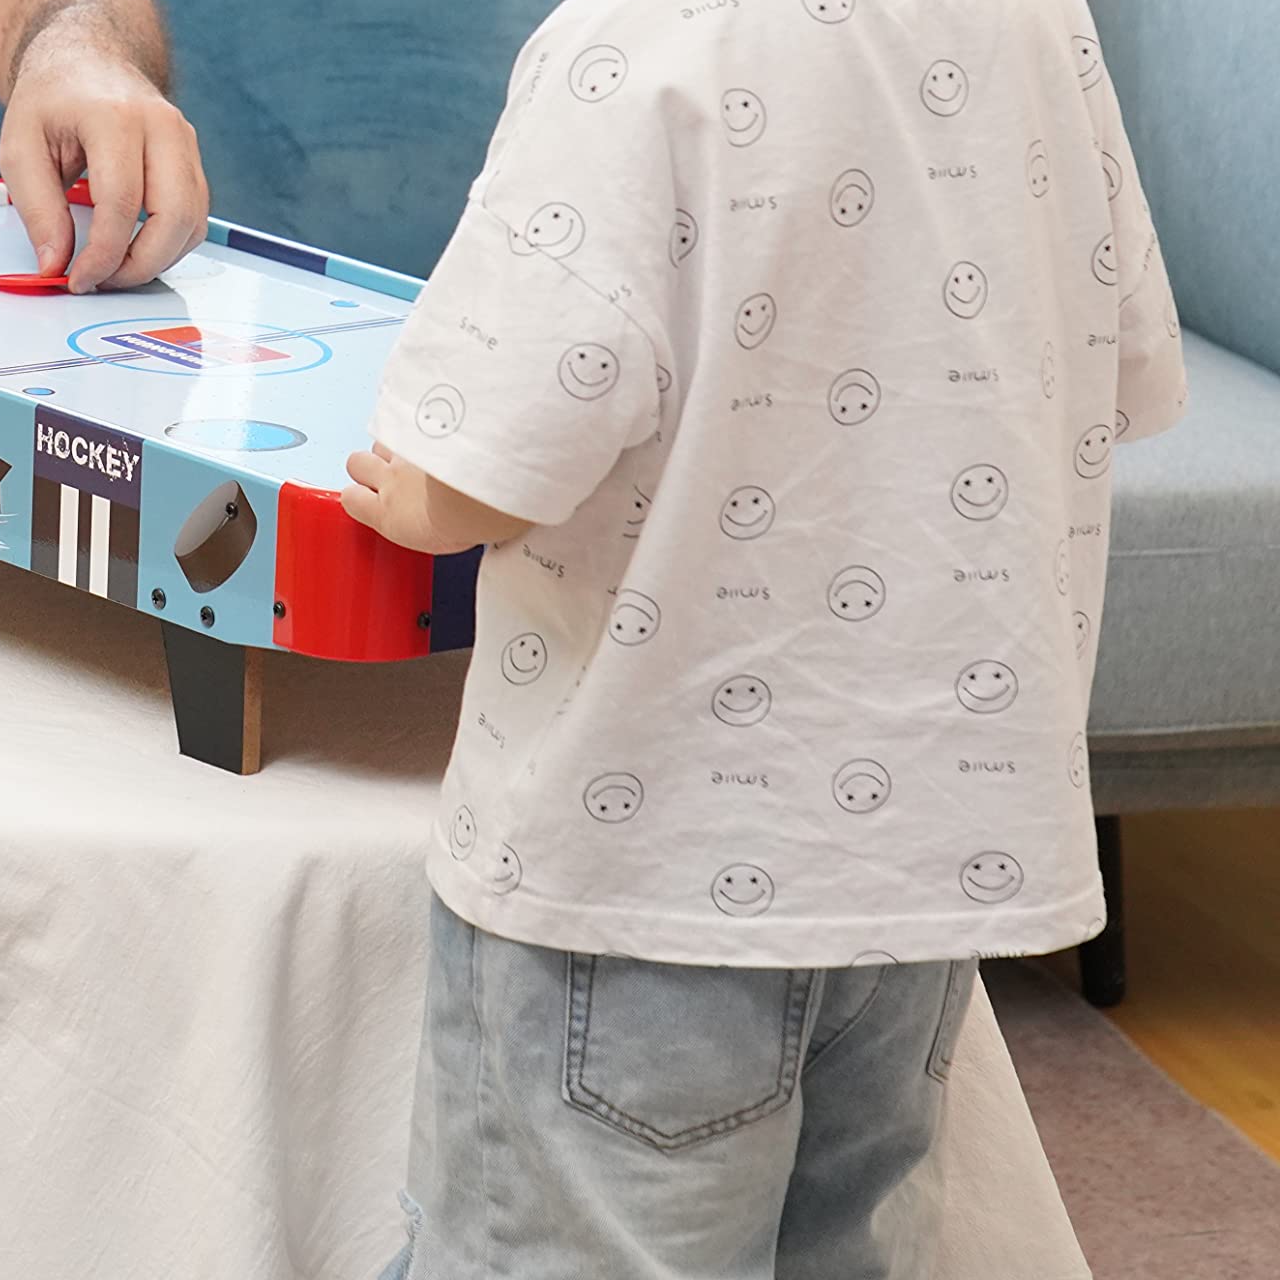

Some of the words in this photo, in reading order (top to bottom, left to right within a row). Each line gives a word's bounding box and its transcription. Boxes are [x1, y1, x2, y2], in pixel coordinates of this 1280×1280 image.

[927, 164, 979, 181] smile
[730, 195, 778, 214] smile
[1087, 333, 1118, 348] mile
[947, 369, 1000, 384] smile
[731, 393, 774, 414] smile
[36, 423, 140, 483] HOCKEY
[522, 543, 566, 579] smile
[952, 568, 1011, 584] smile
[716, 586, 771, 601] smile
[958, 759, 1017, 775] smile
[711, 771, 770, 789] smile
